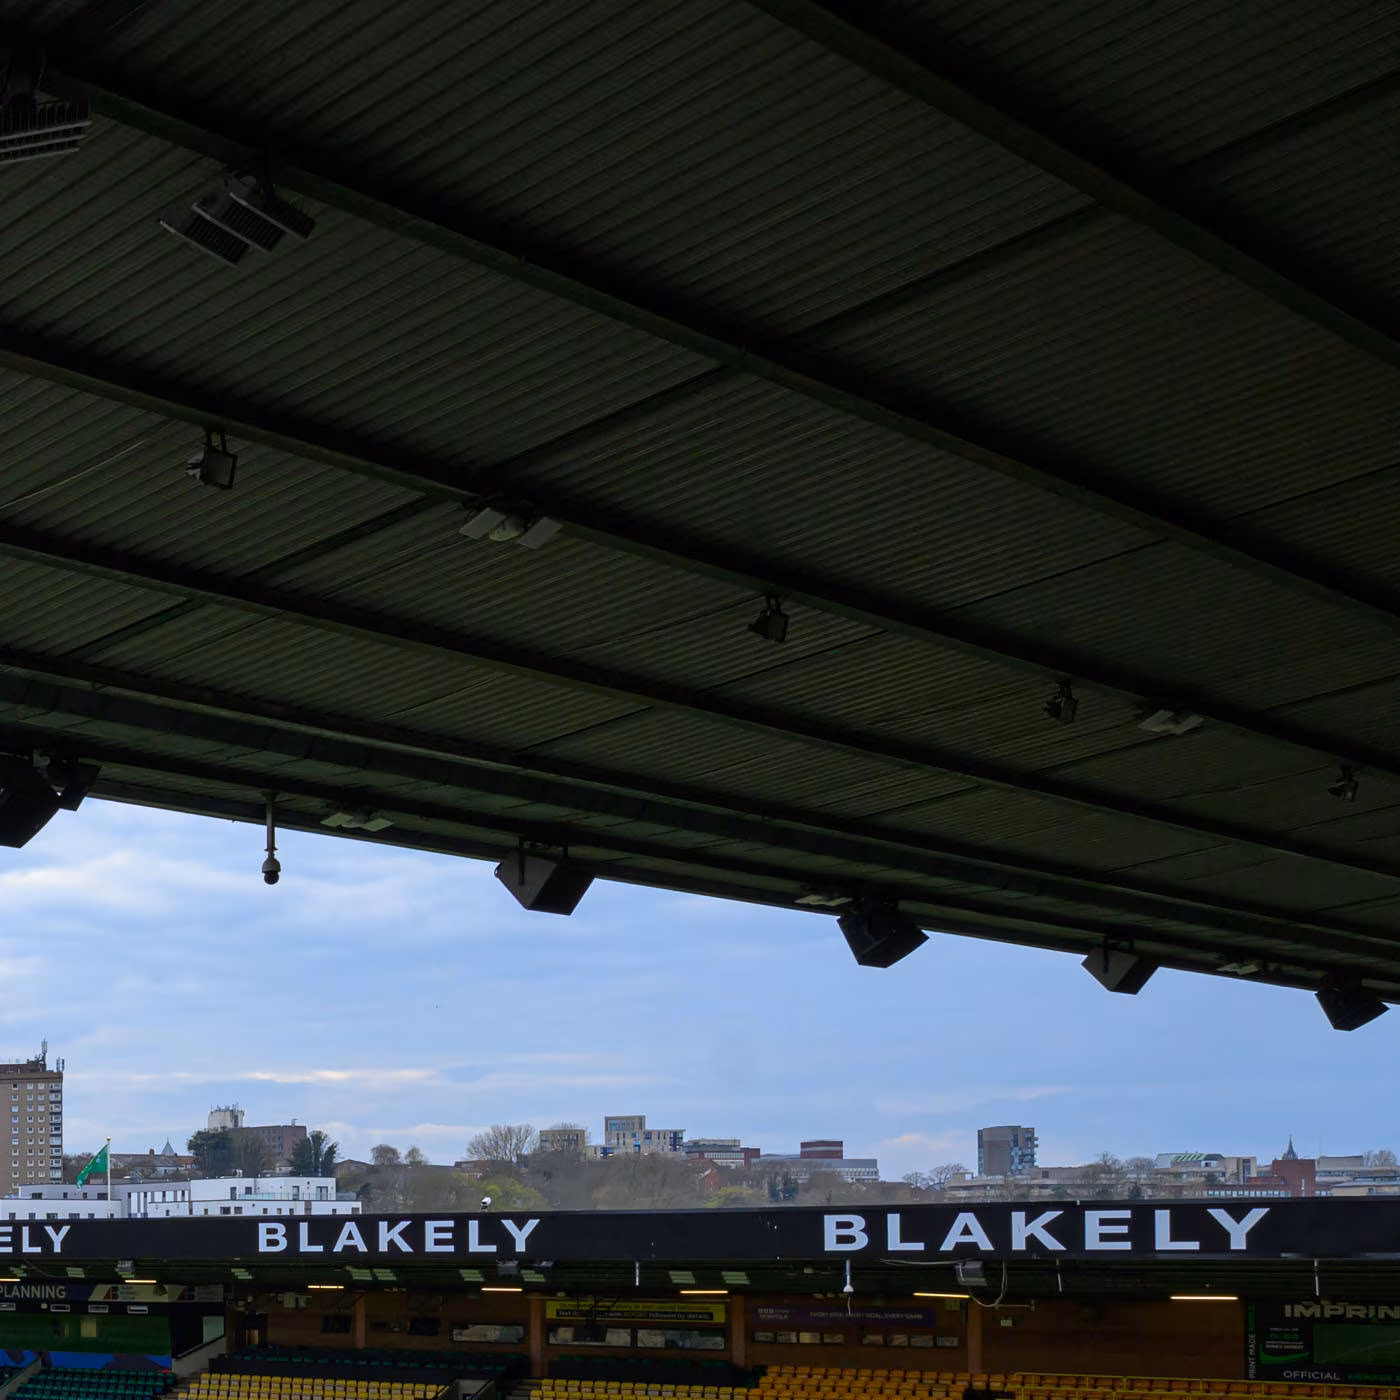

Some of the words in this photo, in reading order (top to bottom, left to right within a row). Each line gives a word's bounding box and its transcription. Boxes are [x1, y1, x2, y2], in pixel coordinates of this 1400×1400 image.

[258, 1219, 541, 1252] BLAKELY
[823, 1208, 1271, 1252] BLAKELY
[1283, 1370, 1341, 1381] OFFICIAL
